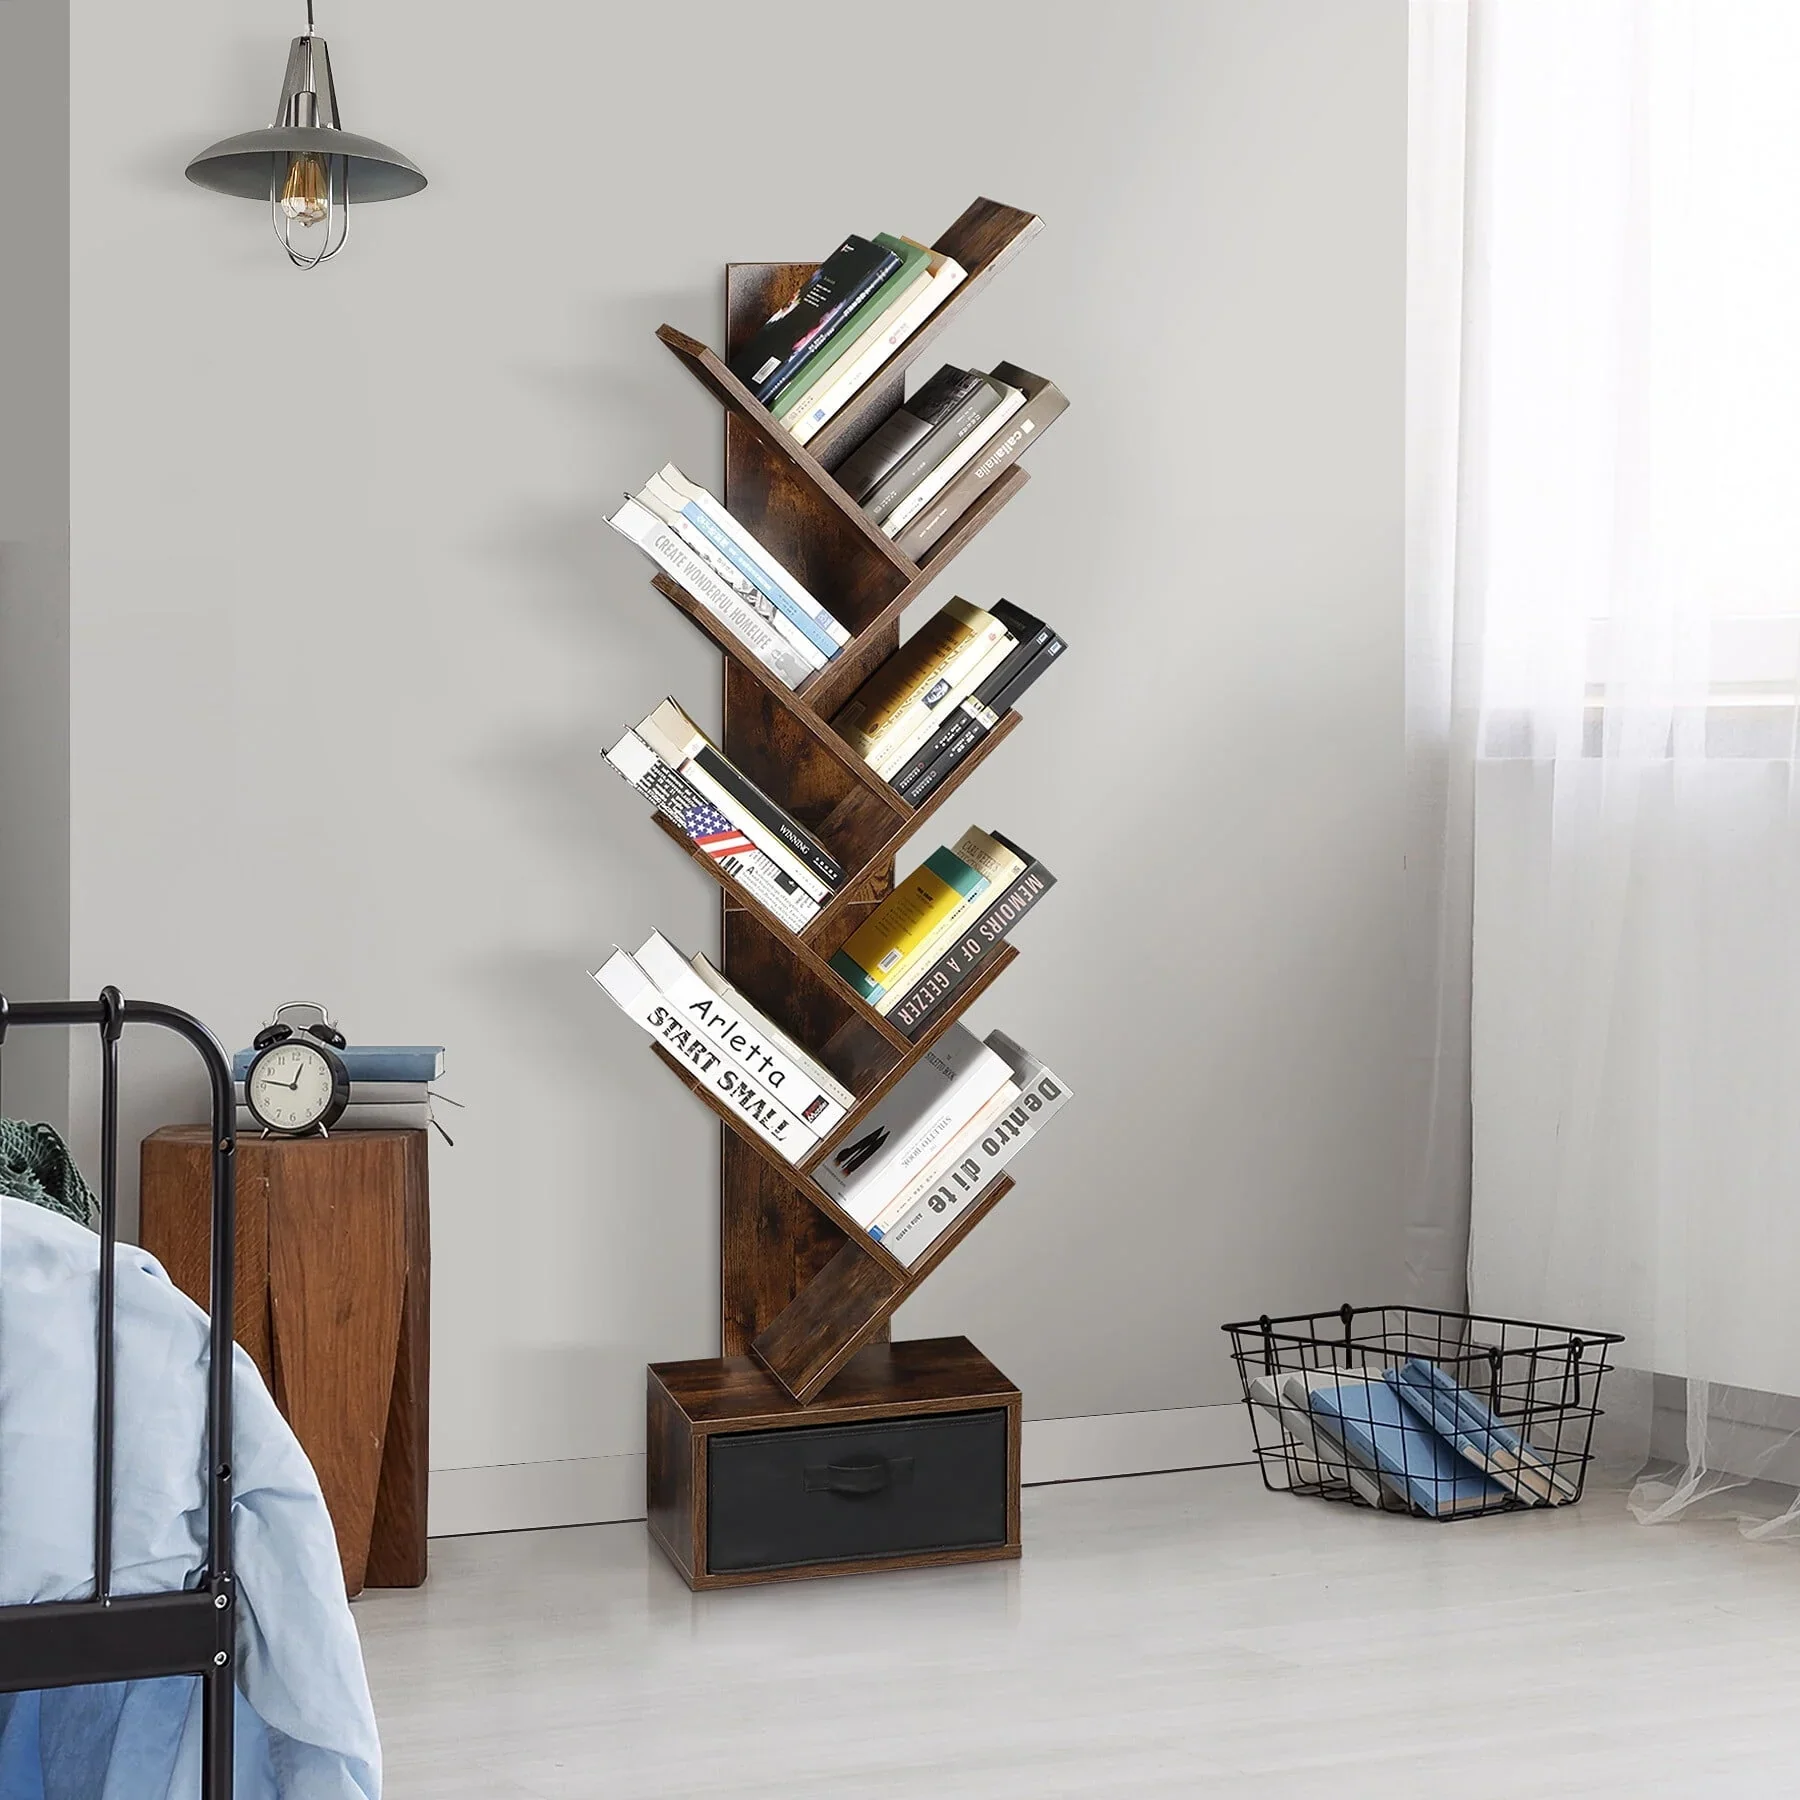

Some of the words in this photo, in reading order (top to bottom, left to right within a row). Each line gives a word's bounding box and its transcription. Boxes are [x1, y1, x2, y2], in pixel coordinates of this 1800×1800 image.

[655, 534, 688, 568] CREATE
[683, 561, 731, 614] WONDERFUL
[729, 607, 772, 650] HOMELIFE
[779, 824, 810, 855] WINNING
[979, 874, 1044, 942] MEMOIRS
[946, 958, 961, 973] A
[961, 938, 981, 962] OF
[897, 971, 950, 1026] GEEZER
[689, 1000, 786, 1089] Arletta
[647, 1006, 721, 1073] START
[717, 1070, 790, 1141] SMALL
[981, 1077, 1063, 1157] Dentro
[927, 1186, 958, 1213] te
[951, 1157, 982, 1191] di
